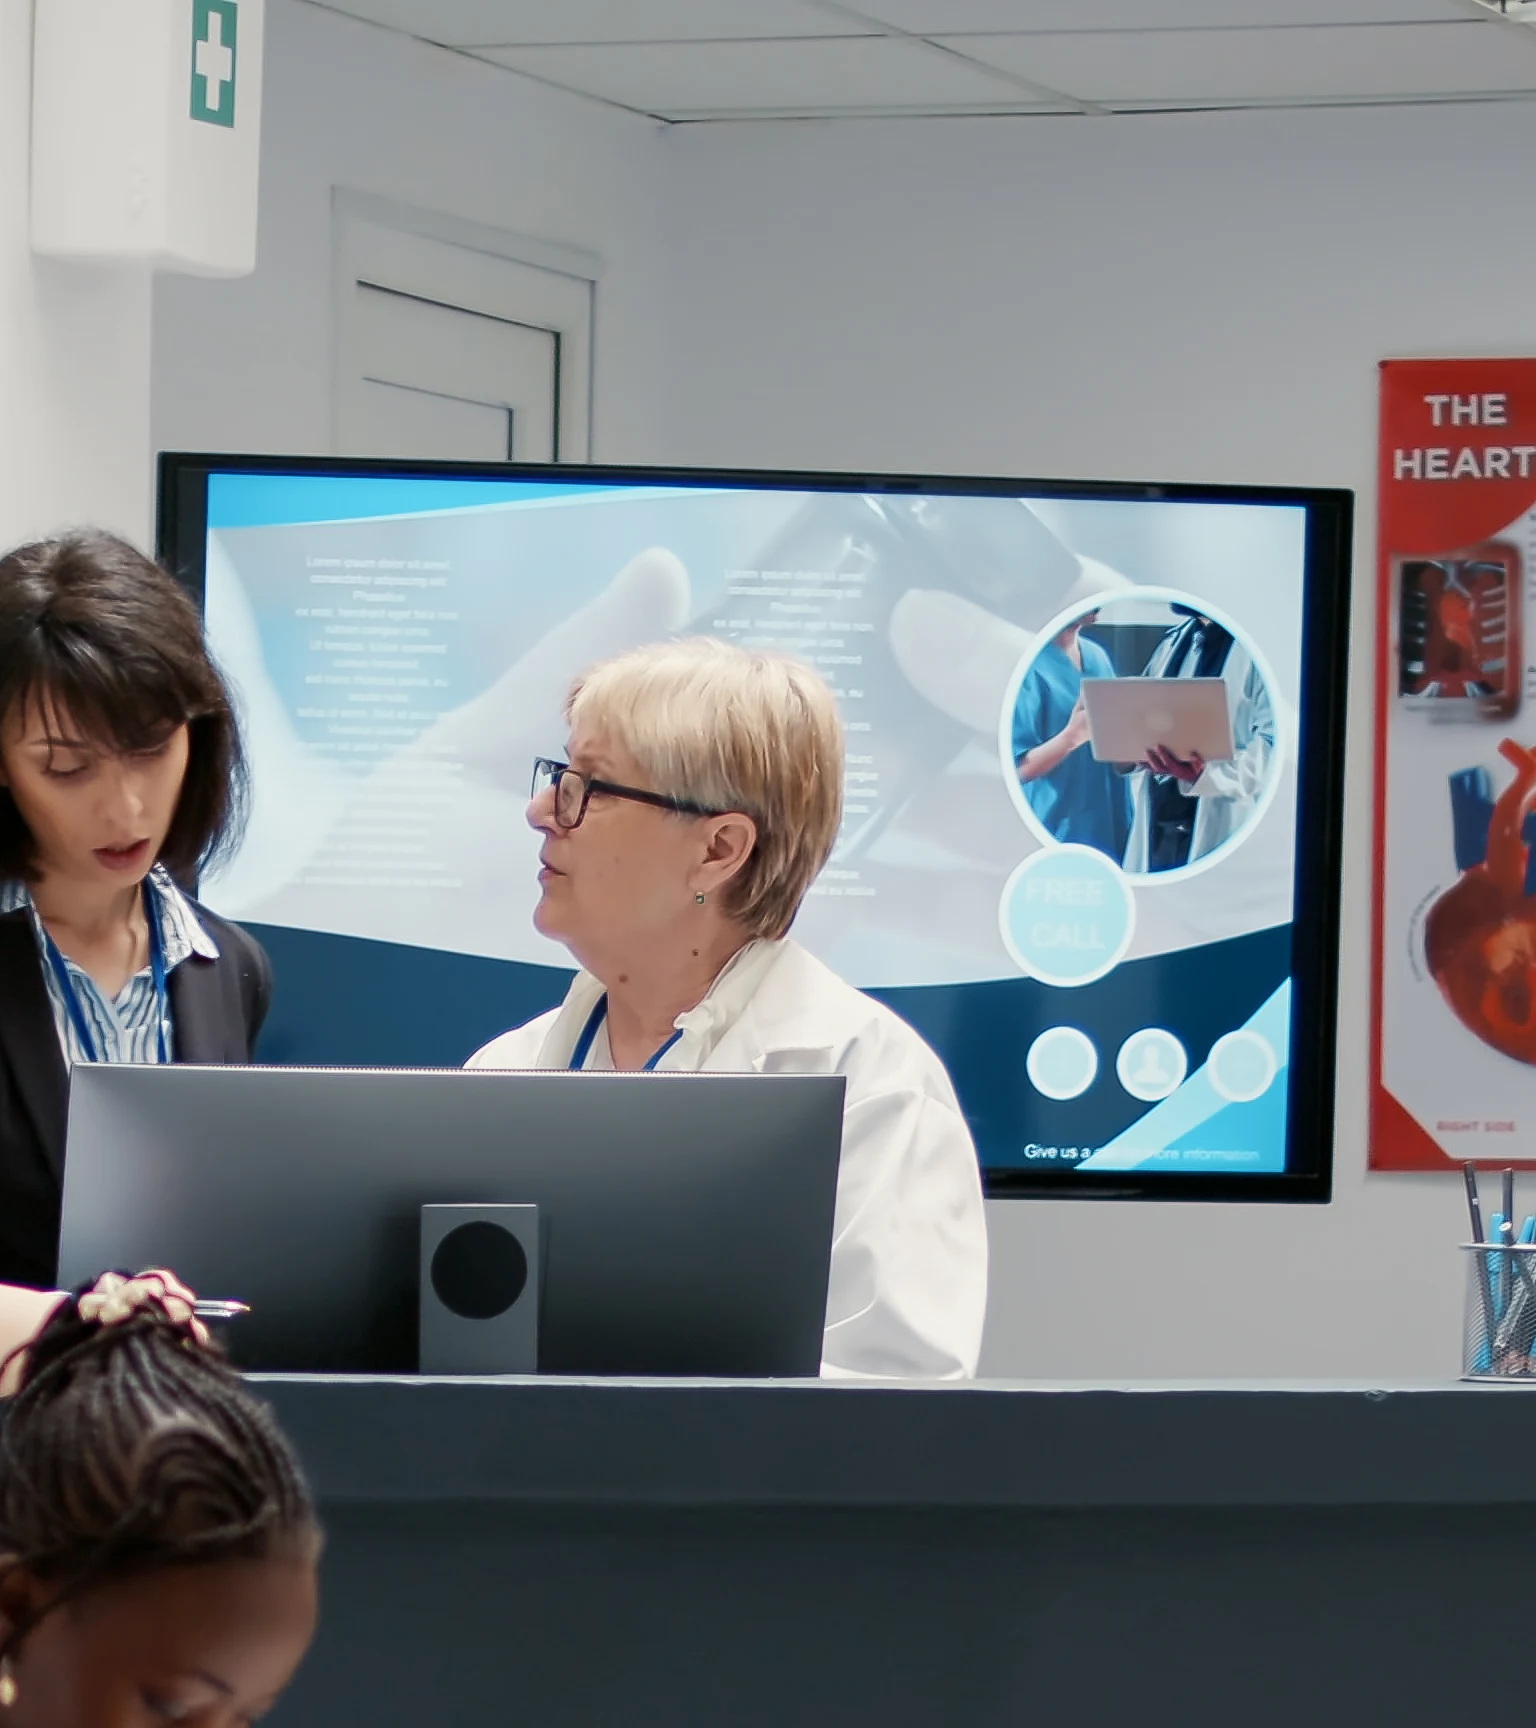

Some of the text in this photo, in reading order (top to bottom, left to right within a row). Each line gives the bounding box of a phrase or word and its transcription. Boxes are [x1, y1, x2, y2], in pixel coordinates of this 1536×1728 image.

[1423, 393, 1507, 425] THE
[1394, 446, 1536, 480] HEART
[306, 555, 342, 568] Lorem
[1026, 879, 1105, 905] FREE
[1032, 922, 1105, 949] CALL
[1484, 1121, 1517, 1132] SIDE
[1023, 1143, 1057, 1160] Give
[1059, 1146, 1078, 1160] us
[1080, 1147, 1090, 1160] a
[1183, 1147, 1261, 1161] information
